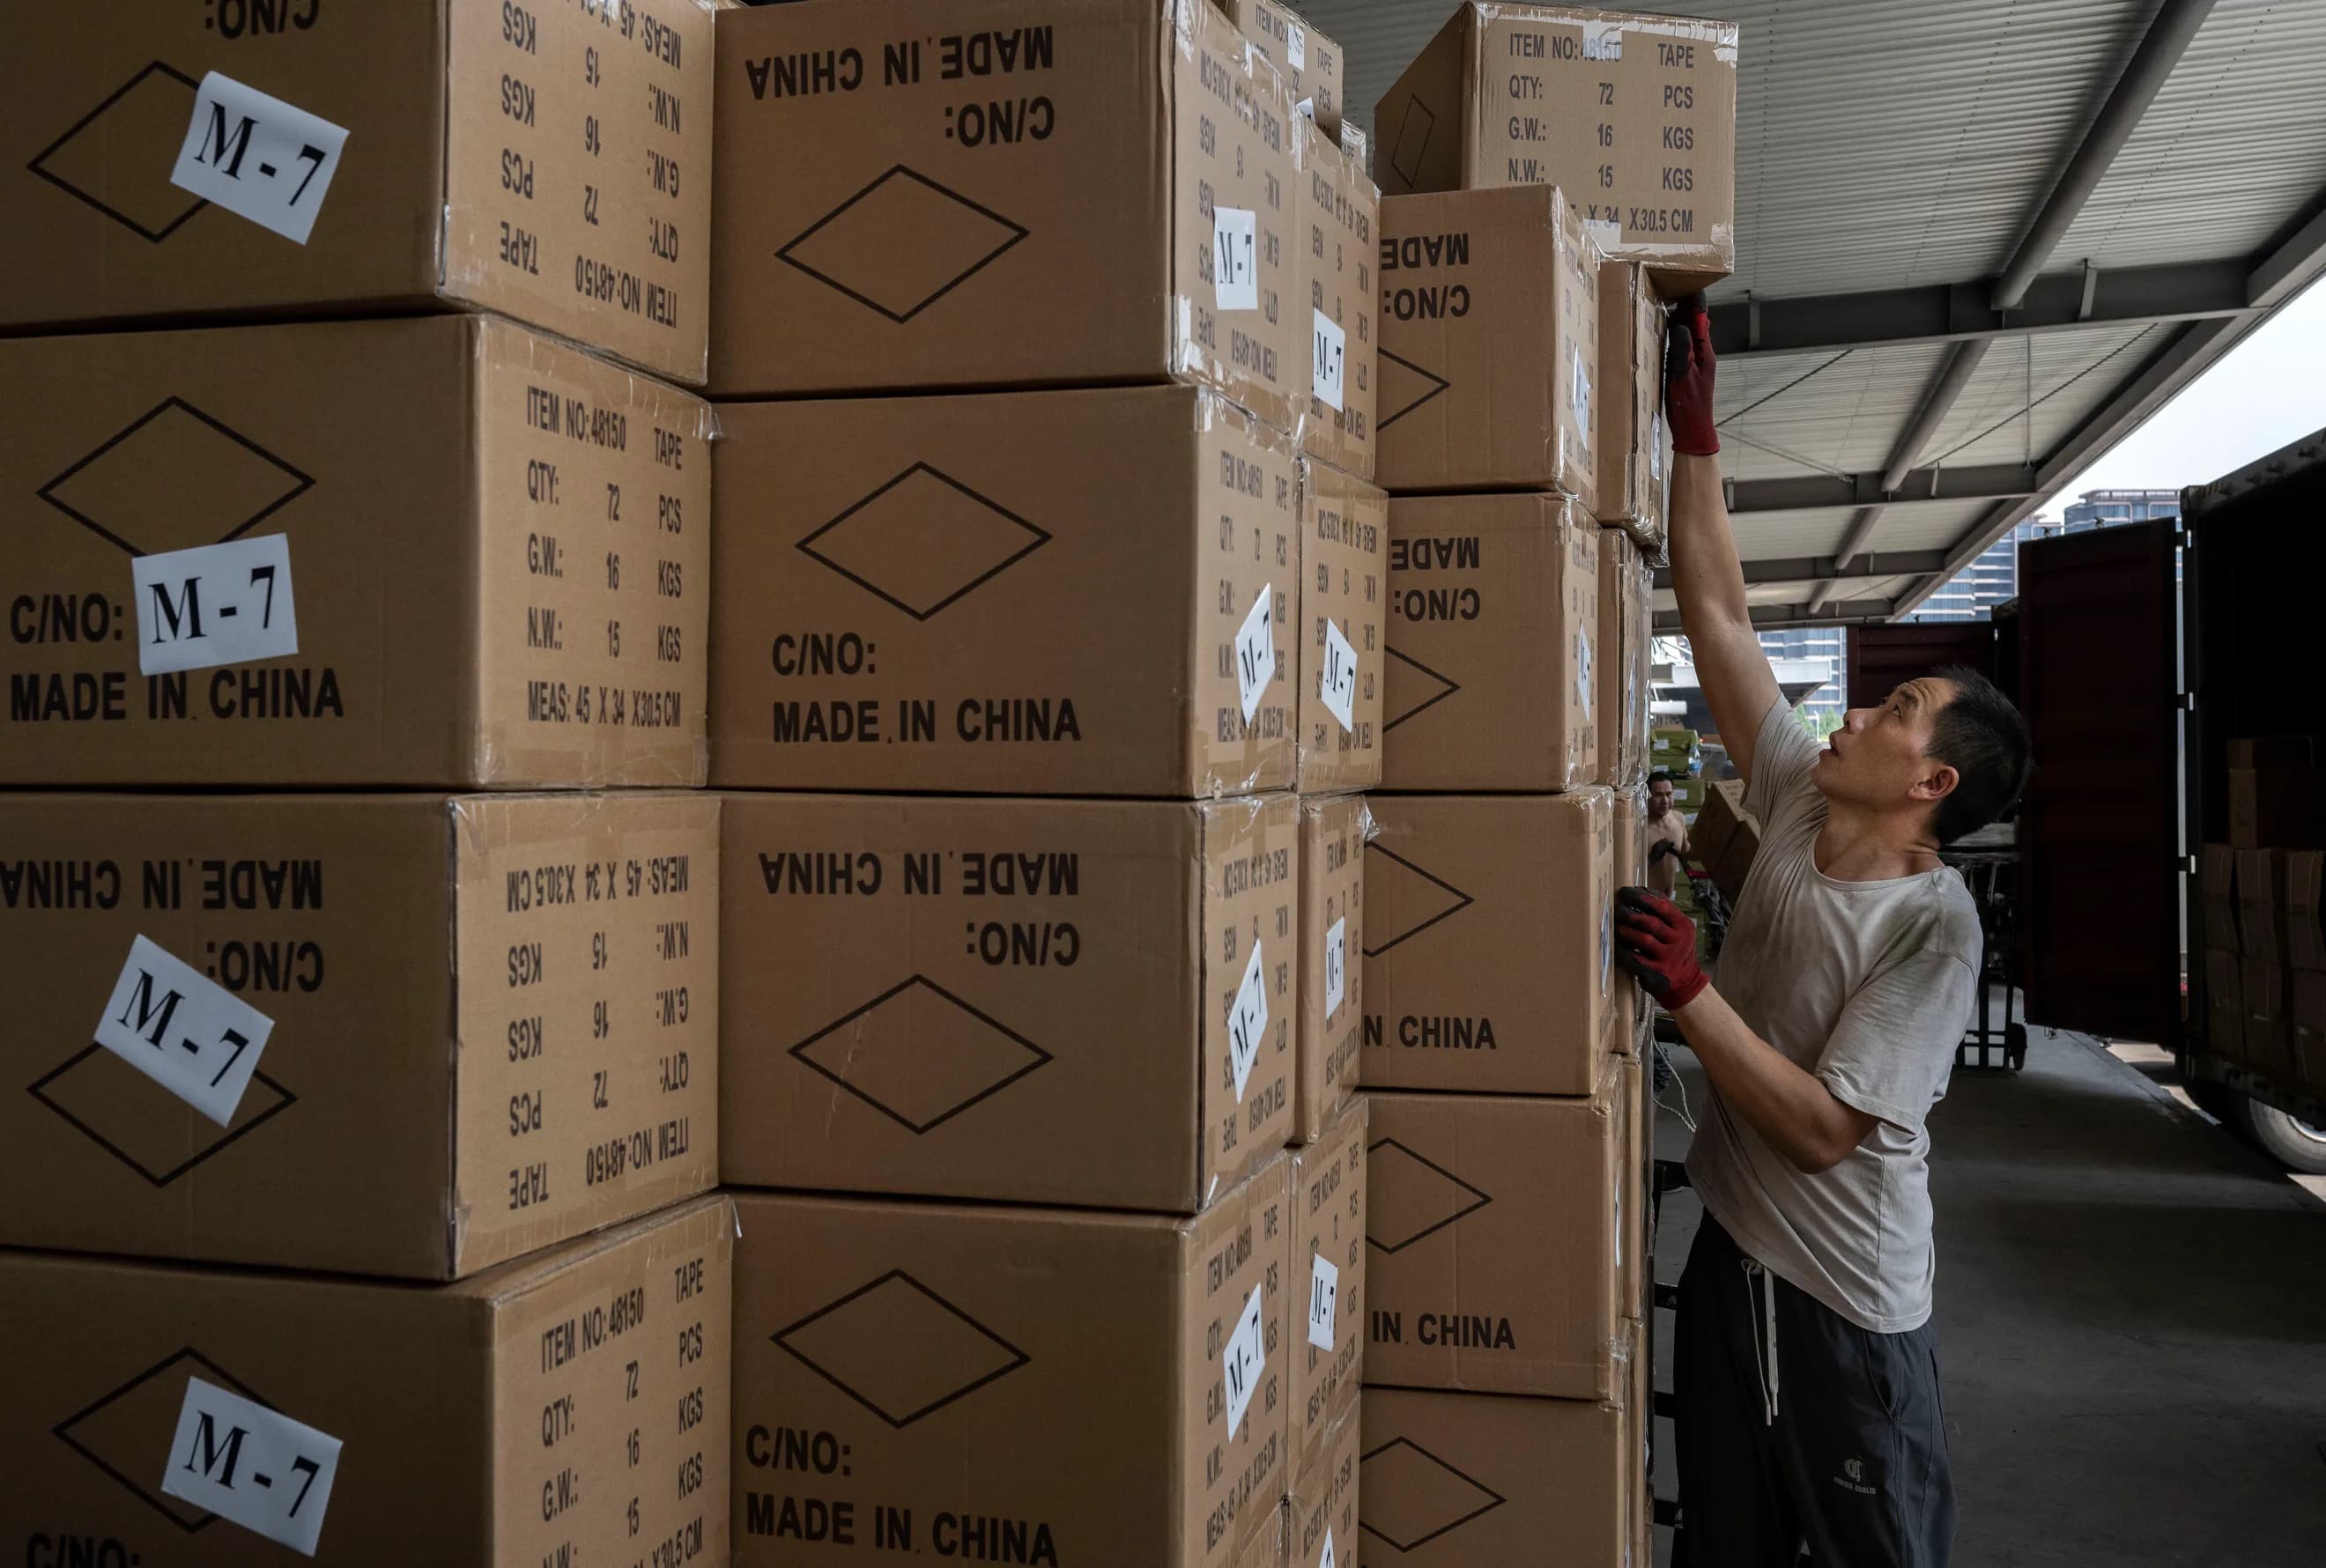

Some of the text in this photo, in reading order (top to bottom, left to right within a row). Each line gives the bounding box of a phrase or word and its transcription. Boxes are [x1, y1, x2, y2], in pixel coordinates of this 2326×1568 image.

[620, 0, 635, 40] 45
[641, 11, 681, 70] MEAS:
[503, 0, 680, 134] N.W.: 15 KGS
[745, 26, 1053, 100] MADE IN CHINA
[1317, 47, 1332, 76] TAPE
[1510, 33, 1544, 59] ITEM
[1657, 42, 1694, 69] TAPE
[1318, 85, 1330, 111] PCS
[1509, 76, 1693, 109] QTY: 72 PCS
[501, 74, 678, 198] G.W.: 16 KGS
[945, 97, 1055, 147] C/NO:
[1200, 114, 1215, 159] KGS
[1509, 117, 1693, 150] G.W.: 16 KGS
[1508, 159, 1693, 191] N.W.: 15 KGS
[502, 148, 678, 263] QTY: 72 PCS
[1604, 205, 1619, 229] 34
[1670, 209, 1693, 233] CM
[500, 221, 538, 275] TAPE
[1381, 233, 1469, 270] MADE
[647, 282, 677, 329] ITEM
[1383, 285, 1470, 322] C/NO:
[1198, 306, 1215, 350] TAPE
[527, 386, 559, 433] ITEM
[654, 427, 682, 470] TAPE
[528, 459, 681, 534] QTY: 72 PCS
[528, 533, 681, 598] G.W.: 16 KGS
[1391, 537, 1479, 571] MADE
[10, 594, 123, 645] C/NO:
[1395, 588, 1480, 621] C/NO:
[528, 606, 680, 662] N.W.: 15 KGS
[772, 632, 876, 677] C/NO:
[10, 673, 126, 721] MADE
[209, 669, 344, 719] CHINA
[528, 680, 570, 722] MEAS:
[576, 684, 589, 723] 45
[599, 686, 607, 723] X
[613, 689, 625, 725] 34
[664, 691, 680, 727] CM
[773, 698, 1082, 743] MADE IN CHINA
[0, 860, 323, 910] MADE IN CHINA
[507, 870, 530, 913] CM
[586, 863, 600, 900] 34
[607, 862, 617, 900] X
[627, 860, 641, 897] 45
[648, 855, 688, 895] MEAS:
[759, 853, 1078, 895] MADE IN CHINA
[507, 921, 688, 987] N.W.: 15 KGS
[967, 922, 1080, 966] C/NO:
[206, 941, 324, 993] C/NO:
[507, 987, 688, 1062] G.W.: 16 KGS
[1399, 1016, 1496, 1049] CHINA
[510, 1051, 688, 1136] QTY: 72 PCS
[659, 1117, 688, 1161] ITEM
[509, 1162, 548, 1209] TAPE
[1208, 1251, 1223, 1298] ITEM
[1264, 1205, 1277, 1241] TAPE
[1267, 1261, 1277, 1299] PCS
[542, 1319, 575, 1374] ITEM
[675, 1258, 703, 1304] TAPE
[1418, 1313, 1515, 1350] CHINA
[1207, 1318, 1277, 1361] QTY: KGS
[543, 1322, 702, 1447] QTY: 72 PCS
[1265, 1374, 1277, 1416] KGS
[543, 1387, 702, 1522] G.W.: 16 KGS
[746, 1424, 851, 1476] C/NO:
[627, 1452, 702, 1538] 15 KGS
[685, 1515, 702, 1560] CM
[746, 1493, 855, 1544] MADE
[932, 1513, 1057, 1567] CHINA
